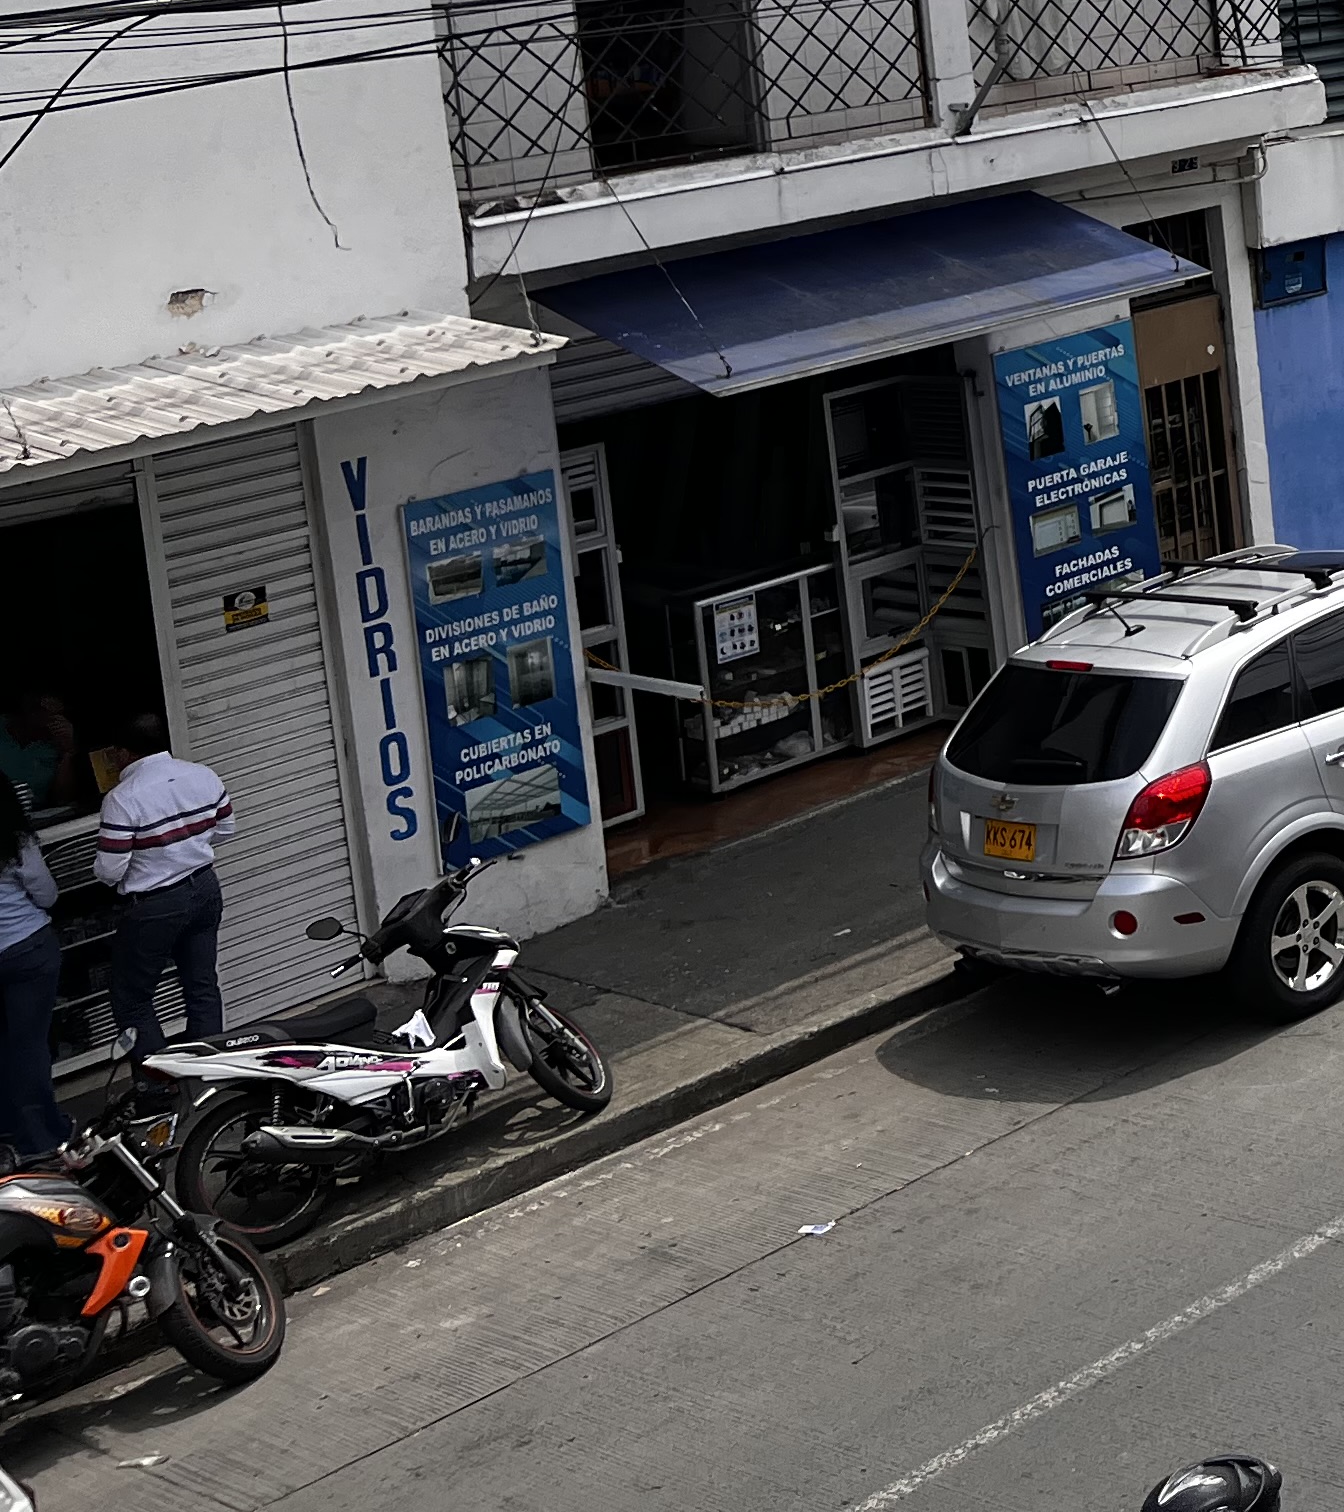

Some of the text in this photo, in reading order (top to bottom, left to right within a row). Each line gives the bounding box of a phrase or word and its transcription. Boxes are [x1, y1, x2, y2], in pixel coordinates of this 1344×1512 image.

[1005, 344, 1125, 387] VENTANAS Y PUERTAS
[1028, 364, 1106, 397] EN ALUMINIO
[1027, 450, 1129, 492] PUERTA GARAJE
[1035, 468, 1128, 507] ELECTRÓNICAS
[409, 487, 553, 536] BARANDAS Y PASAMANOS
[430, 513, 538, 556] EN ACERO Y VIDRIO
[1045, 557, 1133, 597] COMERCIALES
[1055, 545, 1120, 577] FACHADAS
[425, 593, 558, 644] DIVISIONES DE BAÑO
[432, 615, 555, 662] EN ACERO Y VIDRIO
[340, 456, 417, 841] VIDRIOS
[455, 738, 561, 785] POLICARBONATO
[460, 721, 552, 763] CUBIERTAS EN
[986, 824, 1032, 850] KKS 674
